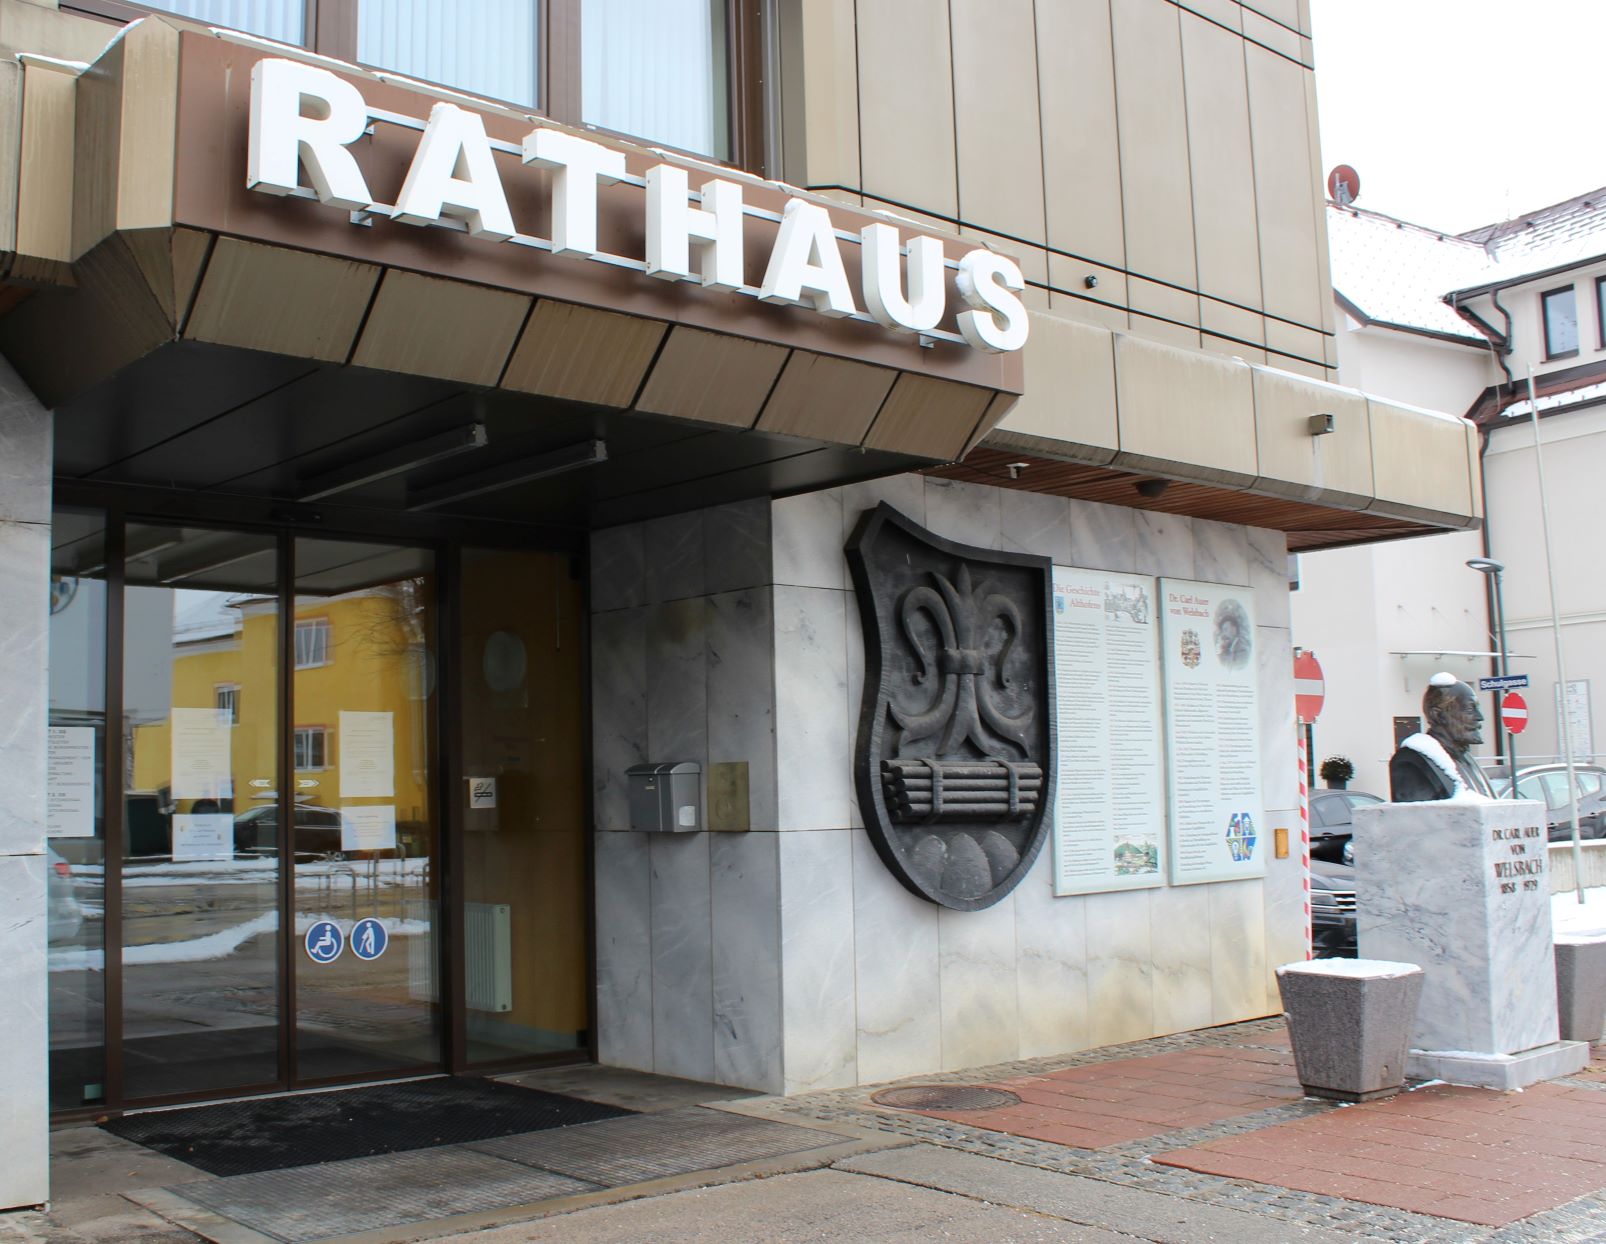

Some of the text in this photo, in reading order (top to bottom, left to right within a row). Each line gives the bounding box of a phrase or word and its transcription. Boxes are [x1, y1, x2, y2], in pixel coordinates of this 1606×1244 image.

[246, 57, 1030, 355] RATHAUS
[1480, 678, 1527, 689] Schulgasse
[1510, 844, 1526, 856] VON
[1494, 859, 1543, 878] WELSBACH
